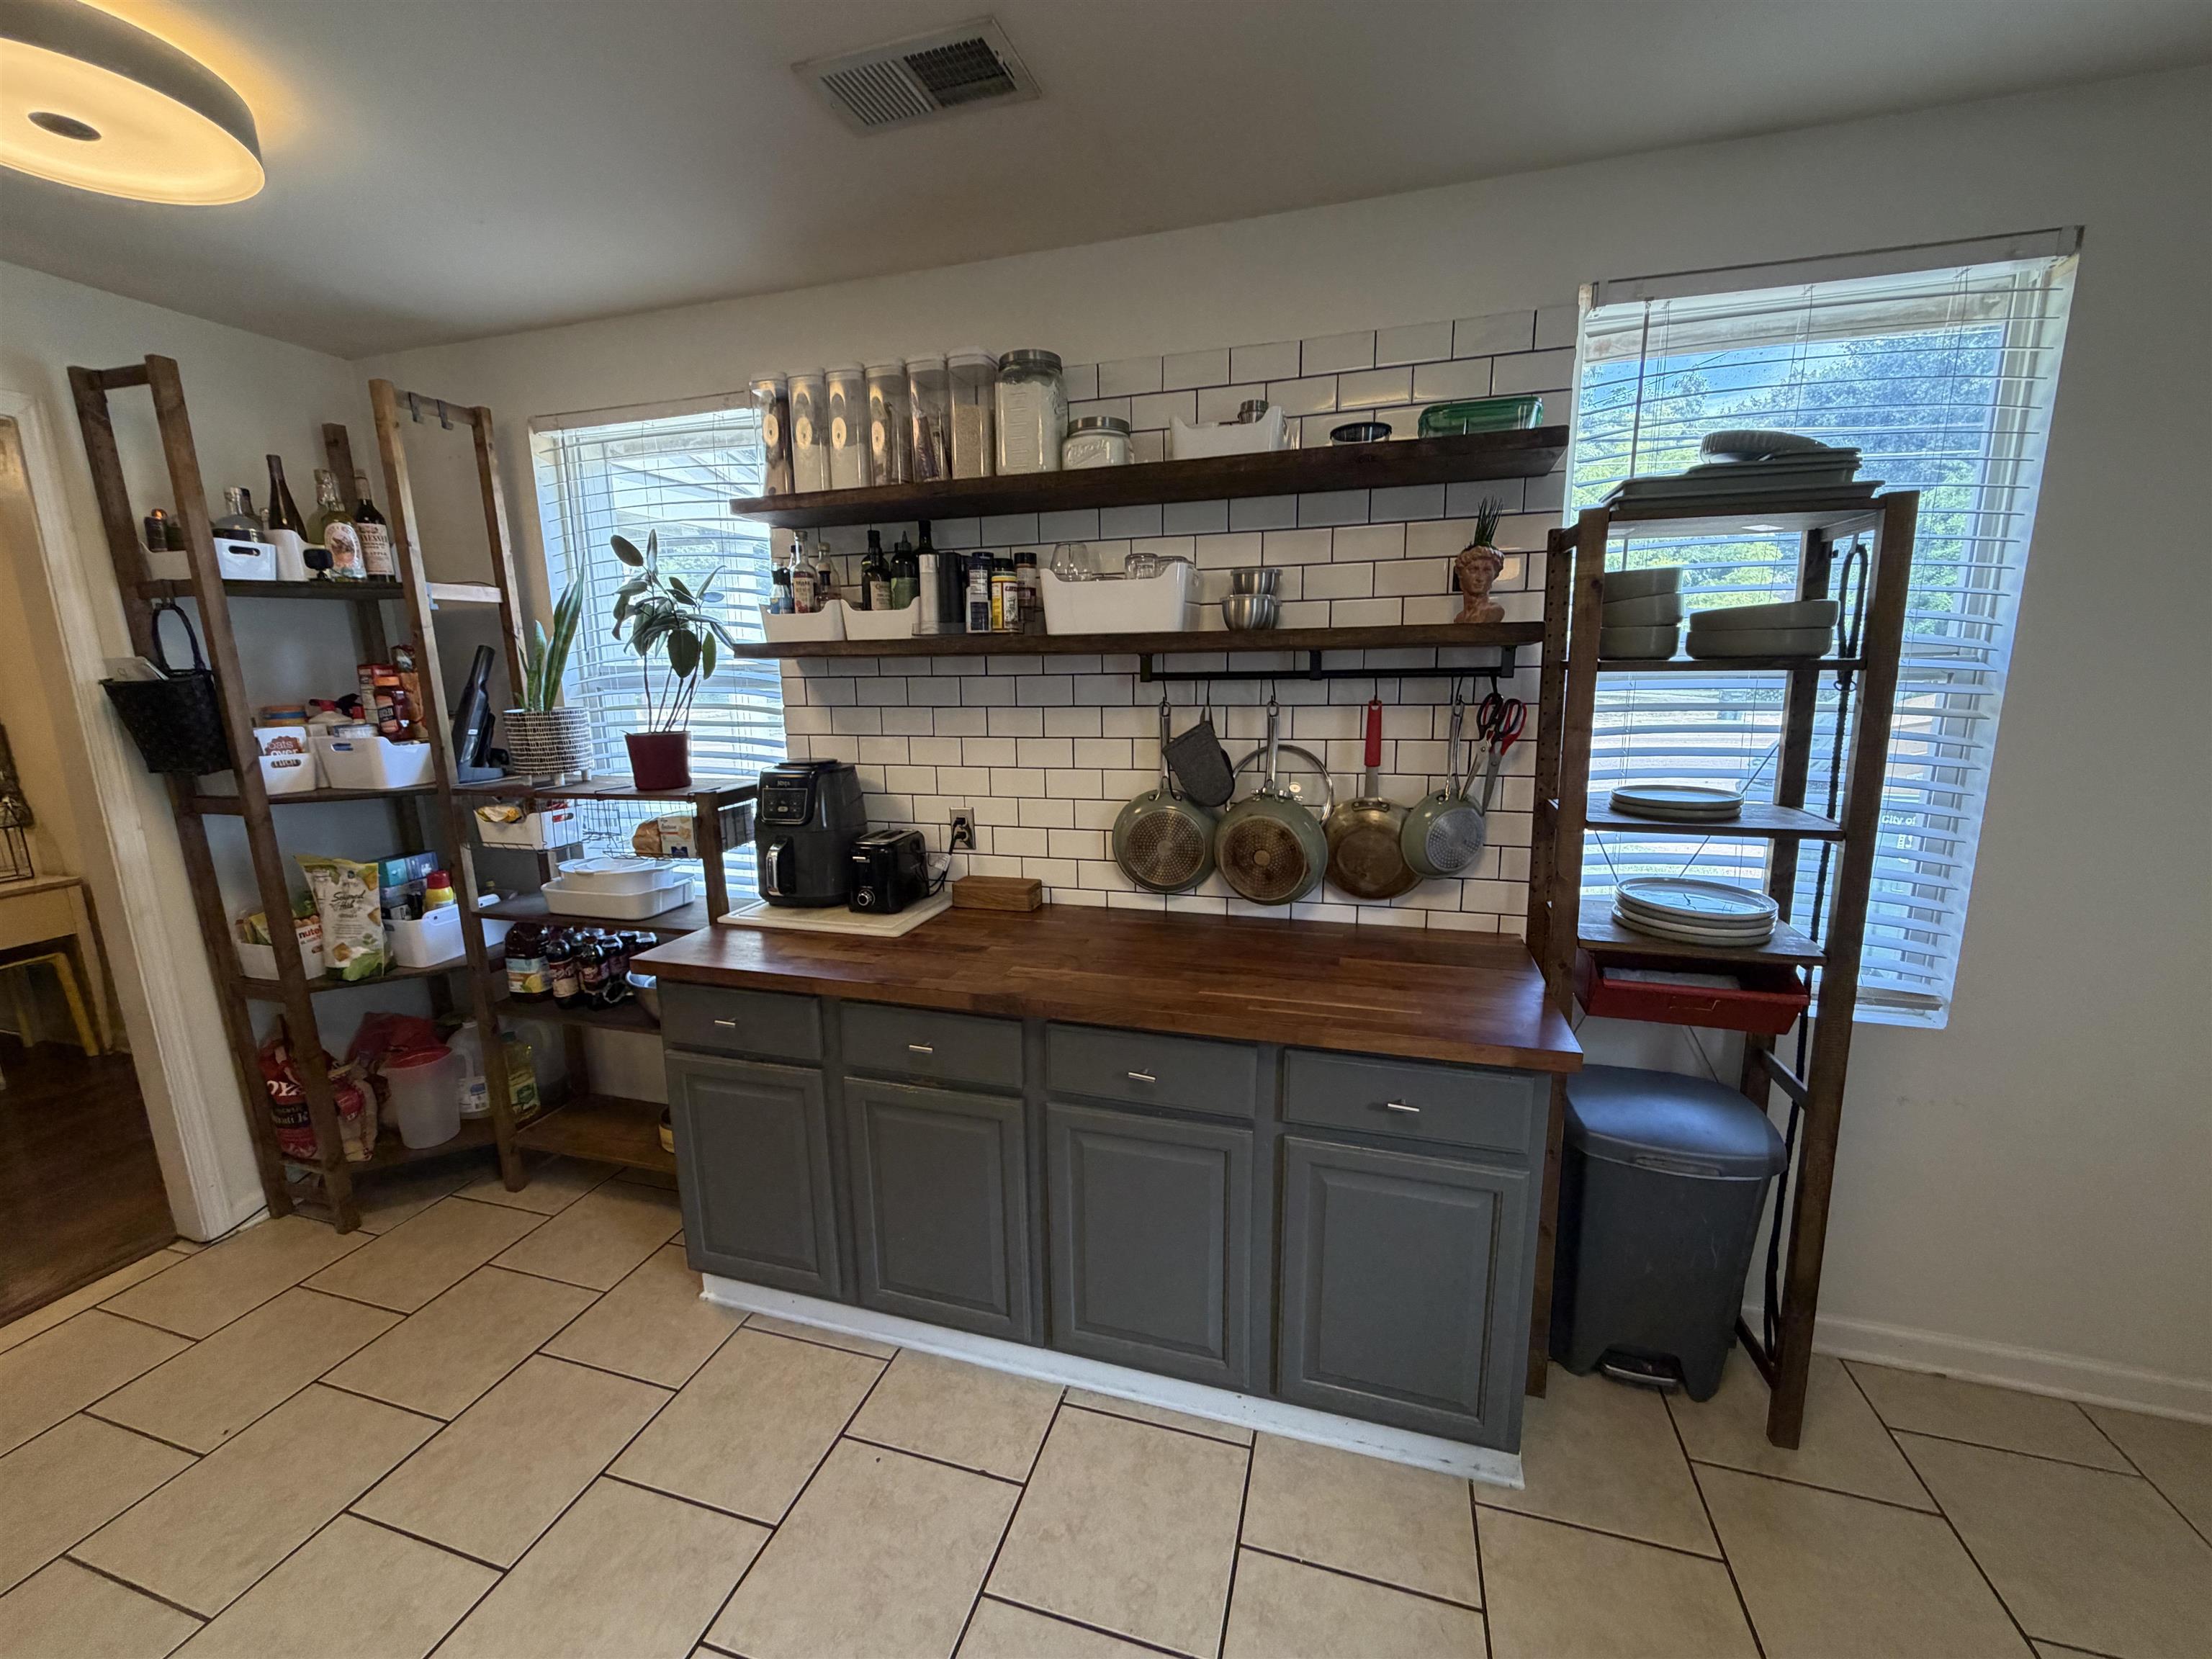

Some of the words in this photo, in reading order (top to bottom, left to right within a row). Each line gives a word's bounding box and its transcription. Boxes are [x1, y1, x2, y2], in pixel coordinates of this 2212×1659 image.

[268, 741, 294, 750] oats
[1881, 814, 1903, 825] City
[1905, 816, 1917, 825] of
